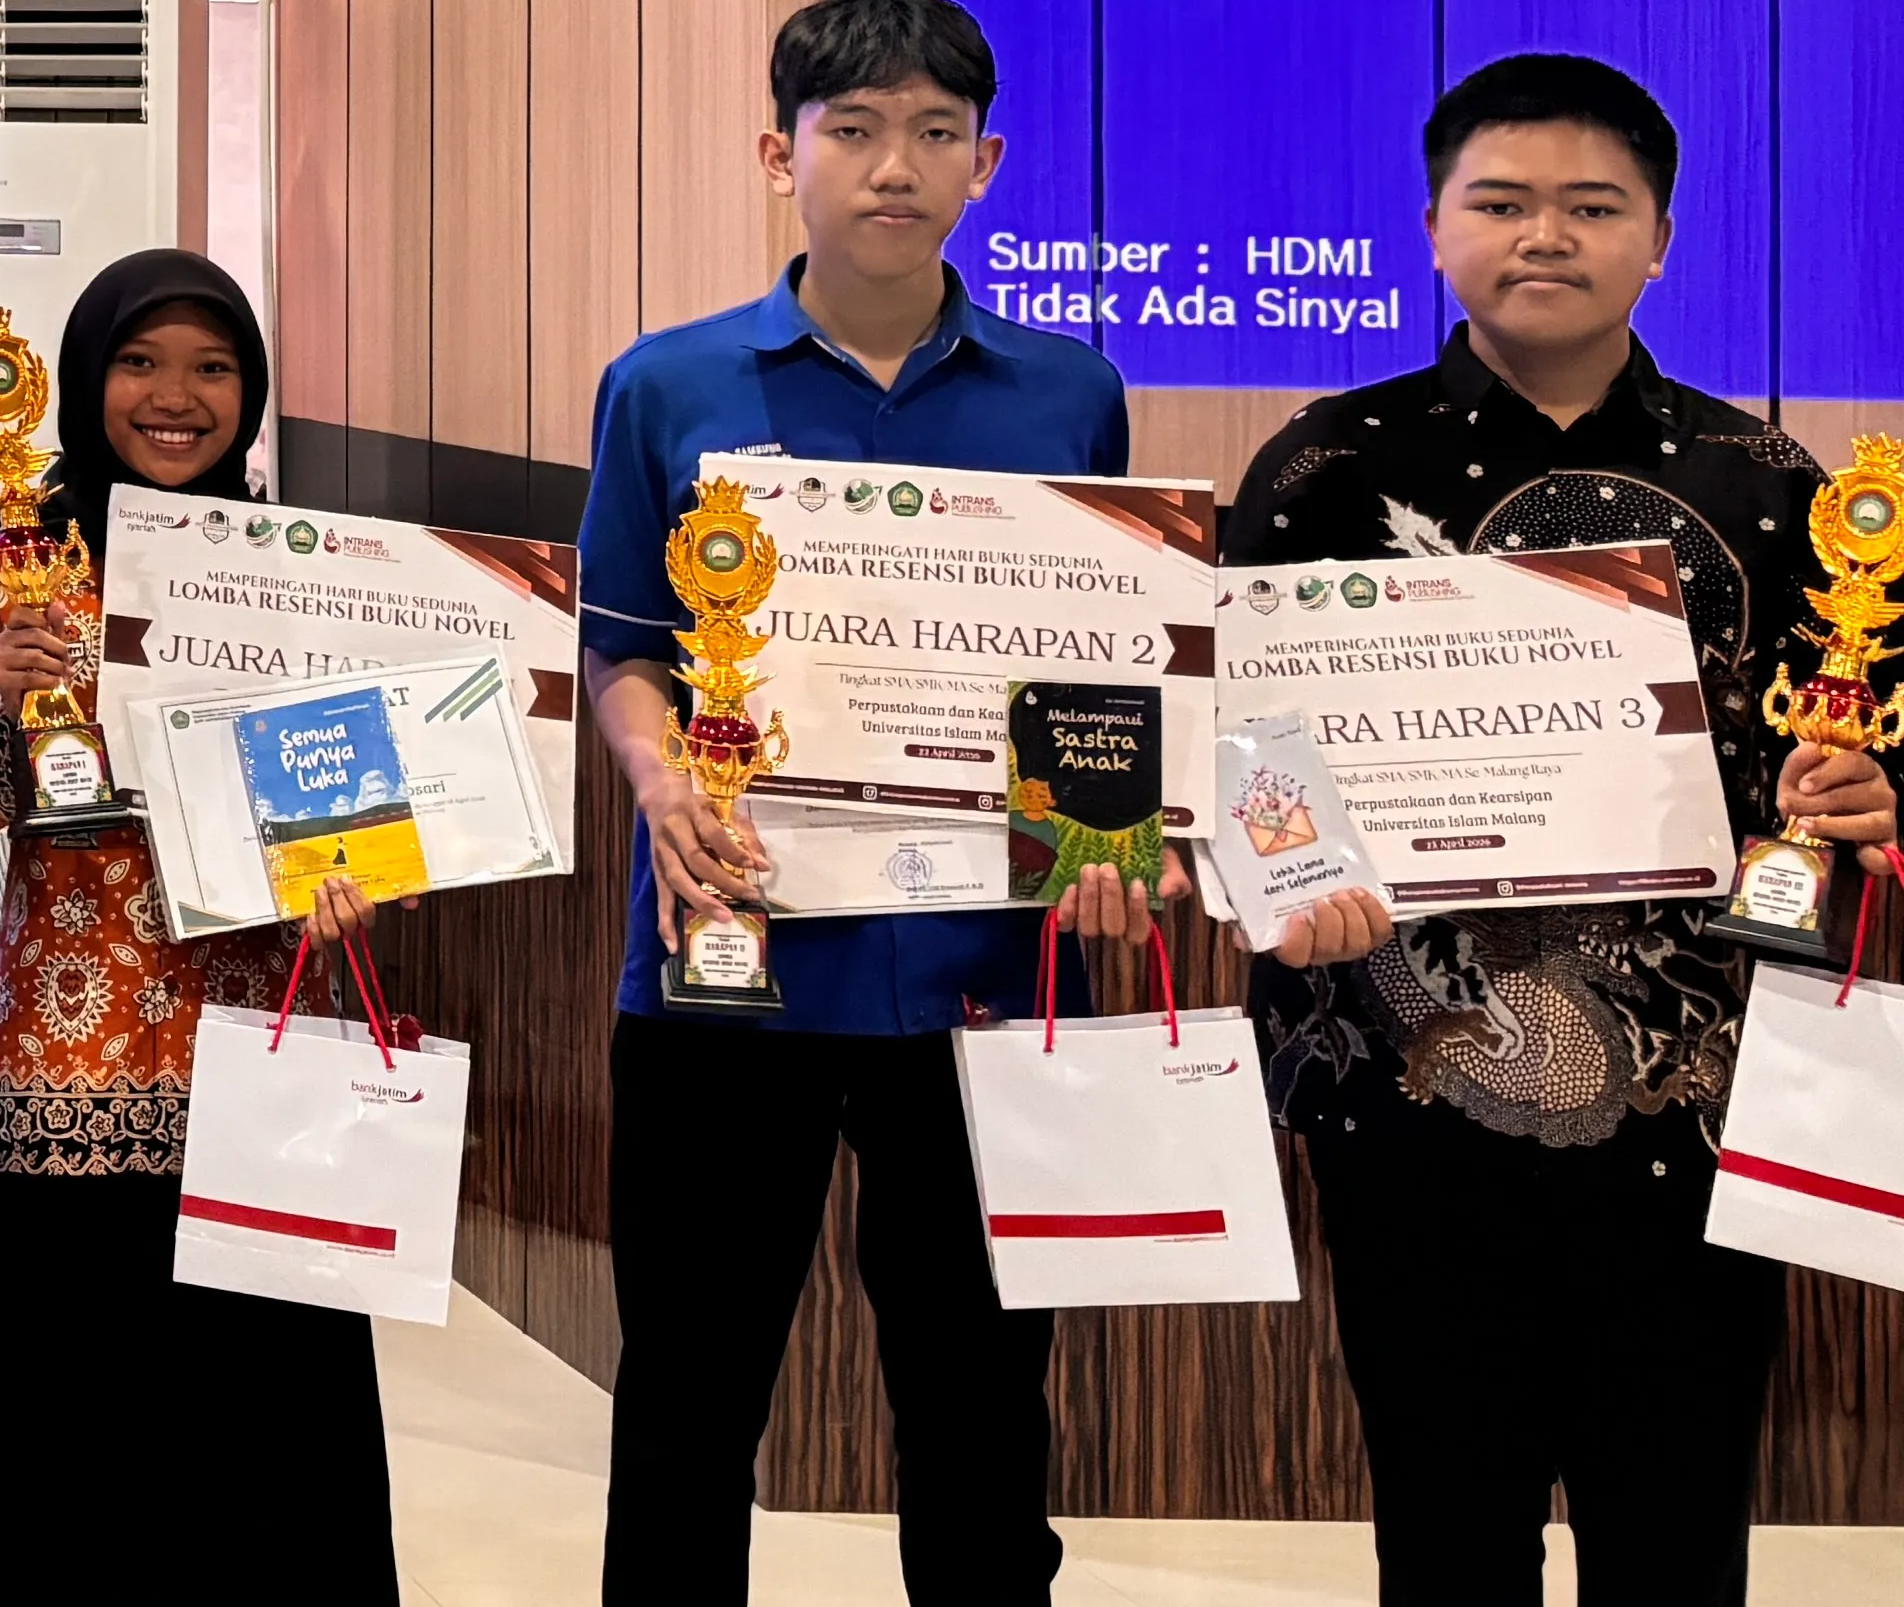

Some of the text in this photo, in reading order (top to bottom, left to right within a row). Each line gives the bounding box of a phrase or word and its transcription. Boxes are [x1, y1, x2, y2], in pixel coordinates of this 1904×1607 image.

[988, 232, 1169, 274] Sumber
[1247, 237, 1372, 277] HDMI
[987, 283, 1399, 334] Tidak Ada Sinyal
[118, 508, 175, 528] bankjatim
[803, 540, 1104, 572] MEMPERINGATI HARI BUKU SEDUNIA
[776, 553, 1146, 596] OMBA RESENSI BUKU NOVEL
[207, 569, 478, 616] MEMPERINGATI HARI BUKU SEDUNIA
[169, 579, 516, 641] LOMBA RESENSI BUKU NOVEL
[754, 608, 1156, 666] JUARA HARAPAN 2
[1265, 626, 1575, 656] MEMPERINGATI HARI BUKU SEDUNIA
[158, 634, 291, 677] JUARA
[1228, 639, 1622, 680] LOMBA RESENSI BUKU NOVEL
[848, 699, 975, 719] Perpustakaan dan
[1046, 708, 1144, 729] Melampaui
[1396, 697, 1646, 742] HARAPAN 3
[278, 722, 347, 752] Semua
[862, 721, 981, 740] Universitas Islam
[1052, 728, 1140, 752] Sastra
[278, 744, 356, 775] Punya
[1058, 751, 1133, 772] Anak
[297, 766, 350, 794] Luka
[1344, 790, 1552, 813] Perpustakaan dan Kearsipan
[1363, 812, 1546, 832] Universitas Islam Malang
